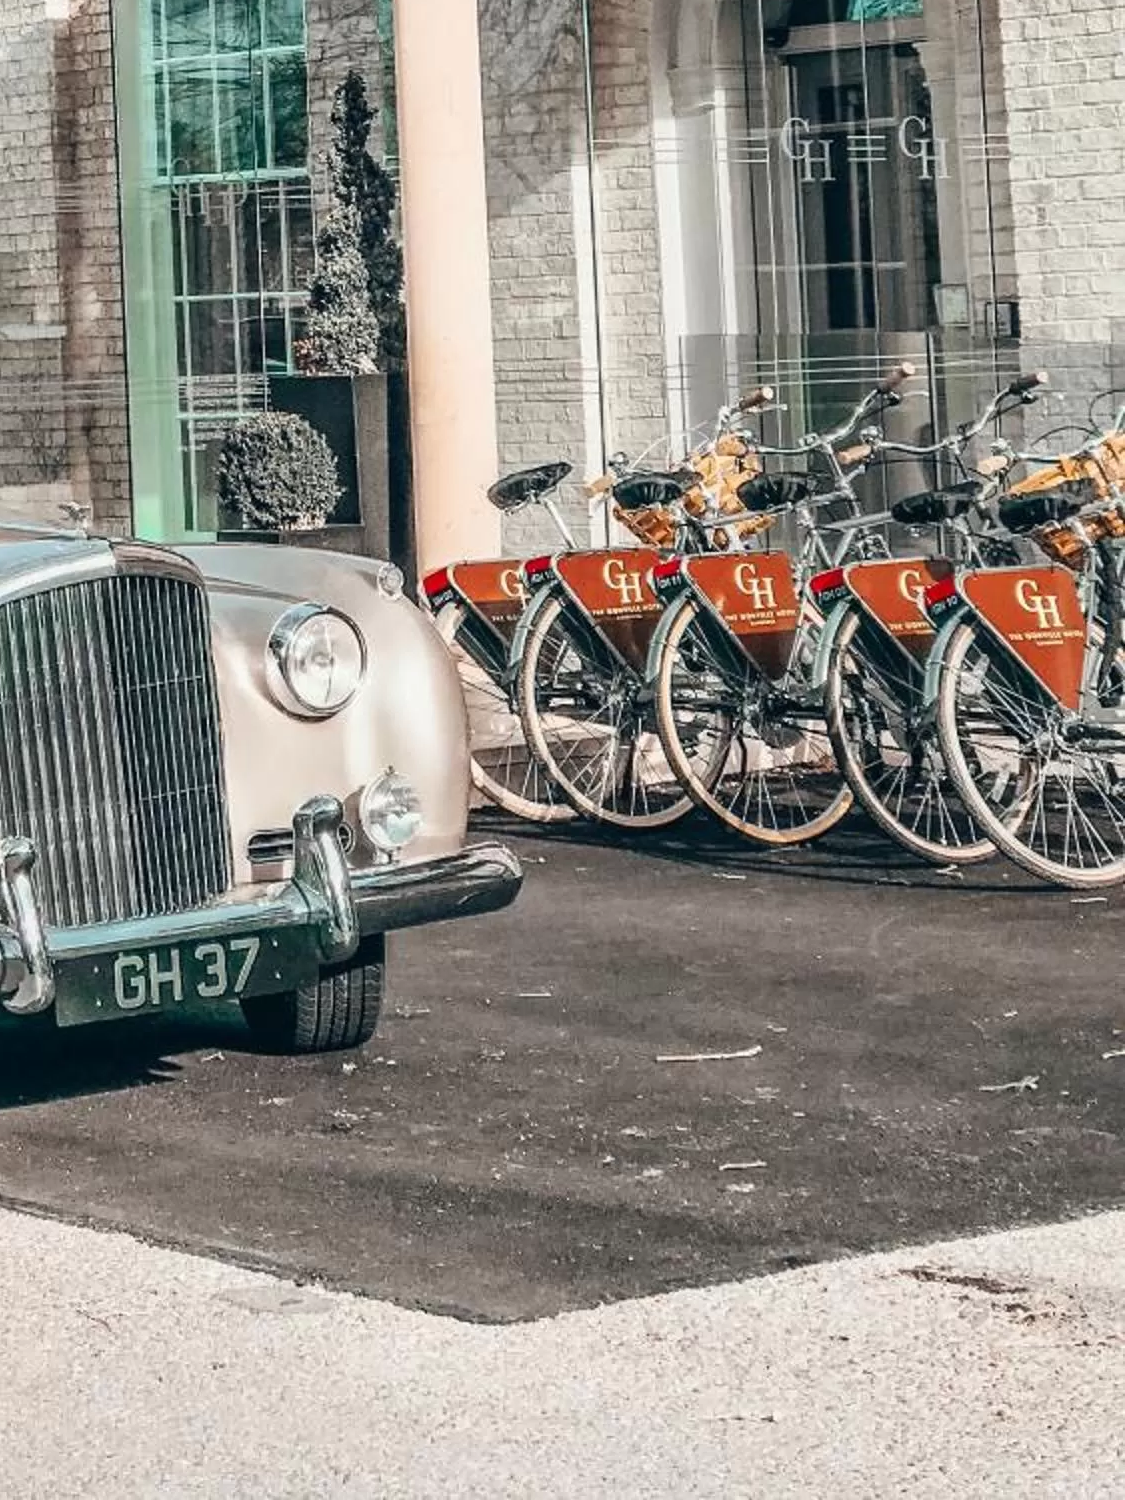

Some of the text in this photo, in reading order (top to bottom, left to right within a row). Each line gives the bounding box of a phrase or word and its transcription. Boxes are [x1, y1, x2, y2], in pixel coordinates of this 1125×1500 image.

[781, 117, 836, 182] GH
[899, 115, 952, 181] GH
[602, 559, 645, 604] GH
[734, 563, 778, 610] GH
[1014, 578, 1065, 629] GH
[113, 937, 261, 1010] GH 37
